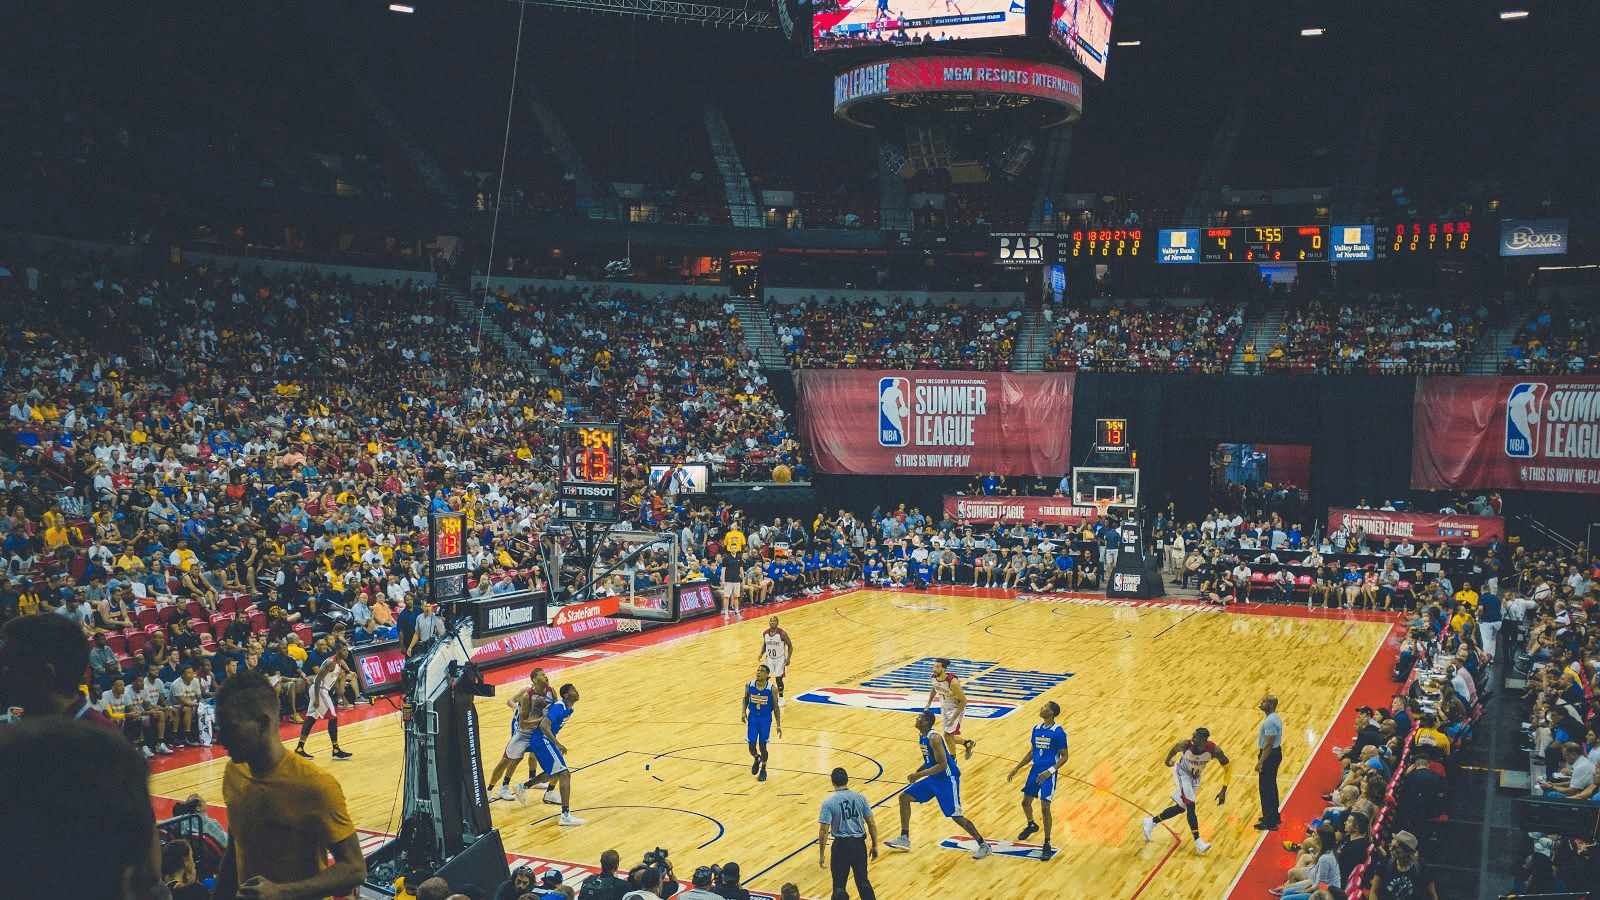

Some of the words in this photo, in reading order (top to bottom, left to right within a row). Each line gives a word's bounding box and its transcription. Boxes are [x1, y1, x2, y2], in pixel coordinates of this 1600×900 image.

[876, 20, 888, 28] CLE
[850, 63, 890, 99] LEAGUE
[944, 68, 973, 80] MGM
[977, 68, 1028, 84] RESORTS
[1397, 224, 1404, 234] 0
[1413, 224, 1420, 234] 5
[1430, 223, 1437, 234] 6
[1443, 222, 1454, 233] 15
[1457, 222, 1470, 233] 32
[1073, 231, 1082, 241] 10
[1088, 231, 1097, 240] 18
[1099, 230, 1111, 240] 20
[1114, 230, 1126, 240] 27
[1129, 230, 1141, 240] 40
[1256, 228, 1281, 242] 7:55
[1463, 233, 1469, 241] 0
[1075, 241, 1081, 249] 2
[1134, 240, 1140, 248] 0
[1218, 237, 1226, 249] 4
[1312, 236, 1321, 248] 0
[1394, 243, 1400, 251] 0
[1410, 242, 1416, 250] 0
[1460, 241, 1466, 249] 0
[1275, 252, 1280, 260] 2
[1300, 250, 1305, 259] 2
[915, 386, 986, 415] SUMMER
[915, 416, 975, 446] LEAGUE
[1106, 421, 1123, 430] 7:54
[579, 429, 613, 449] 7:54
[882, 430, 898, 442] NBA
[1108, 430, 1121, 444] 13
[1509, 438, 1525, 451] NBA
[583, 449, 608, 481] 13
[902, 454, 918, 467] THIS
[919, 454, 926, 467] IS
[926, 454, 942, 467] WHY
[943, 454, 953, 467] WE
[954, 454, 970, 467] PLAY
[1528, 467, 1546, 482] THIS
[1547, 467, 1555, 482] IS
[1556, 468, 1574, 482] WHY
[1575, 468, 1586, 483] WE
[577, 486, 614, 496] TISSOT
[966, 505, 998, 518] SUMMER
[1044, 507, 1054, 516] THIS
[1055, 507, 1060, 516] IS
[1072, 507, 1079, 516] WE
[1080, 507, 1092, 516] PLAY
[1386, 522, 1414, 538] LEAGUE
[445, 535, 458, 555] 13
[445, 562, 466, 571] TISSOT
[1123, 583, 1138, 592] LEAGUE
[489, 606, 534, 629] #NBASummer
[510, 628, 542, 650] SUMMER
[539, 626, 565, 644] LEAGUE
[587, 617, 613, 630] RESORTS
[767, 648, 777, 657] 20
[471, 756, 481, 806] INTERNATIONAL
[840, 799, 860, 821] 134
